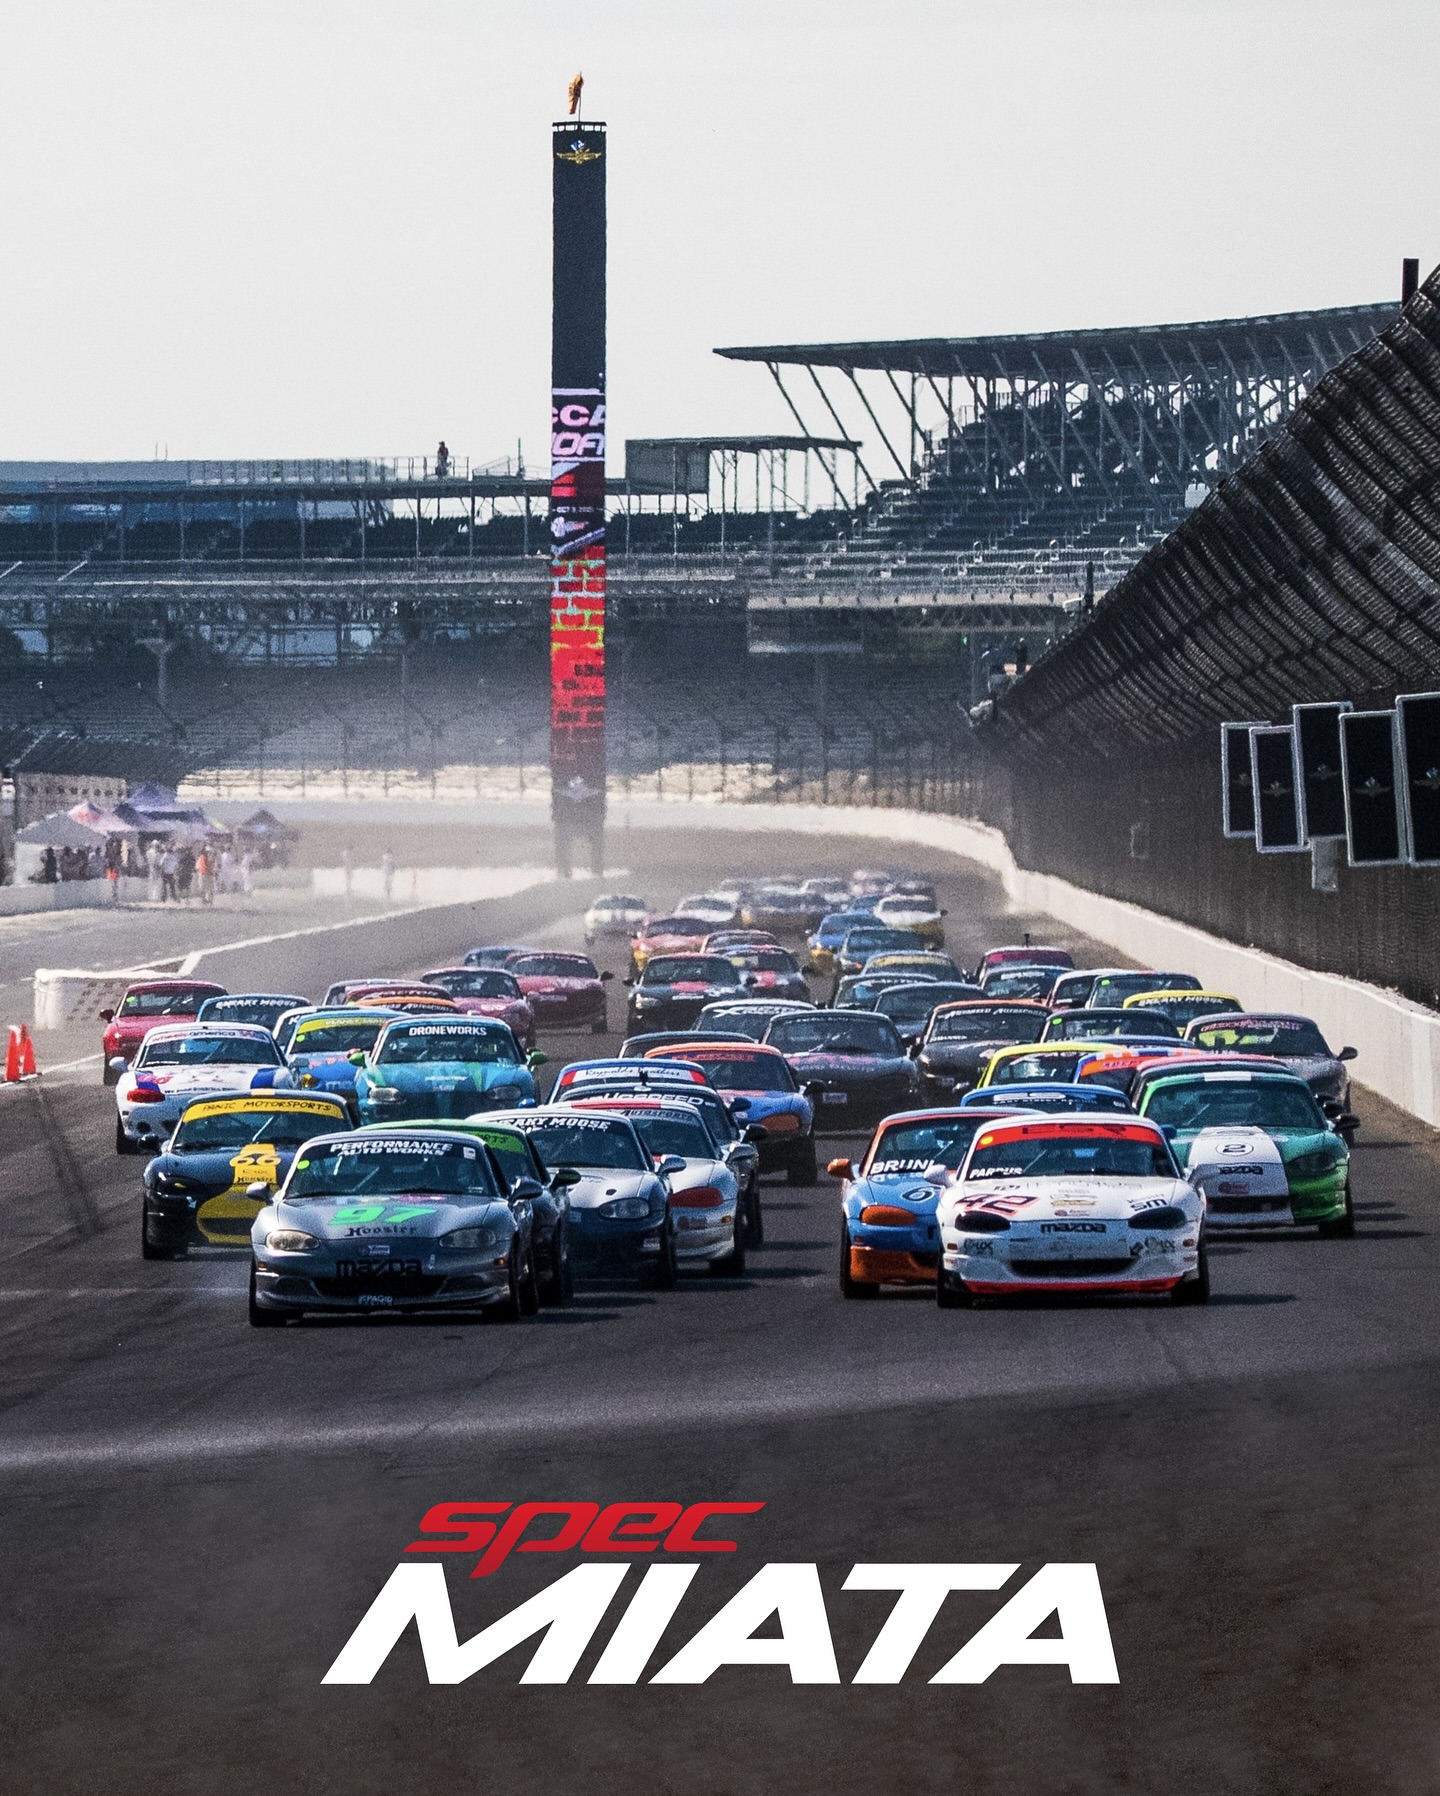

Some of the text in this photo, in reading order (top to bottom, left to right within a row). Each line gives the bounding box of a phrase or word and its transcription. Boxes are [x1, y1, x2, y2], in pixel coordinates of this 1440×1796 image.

[409, 1025, 487, 1036] DRONEWORKS
[243, 1100, 332, 1111] MOTORSPORTS
[549, 1117, 611, 1131] MOOSE
[330, 1140, 453, 1153] PERFORMANCE
[338, 1147, 445, 1156] AUTO WORKS
[1222, 1143, 1246, 1153] 2
[229, 1151, 282, 1167] 66
[954, 1194, 1040, 1216] 42
[328, 1206, 438, 1225] 97
[344, 1225, 417, 1237] Hoosier
[1040, 1222, 1107, 1234] mazda
[336, 1259, 423, 1278] mazda
